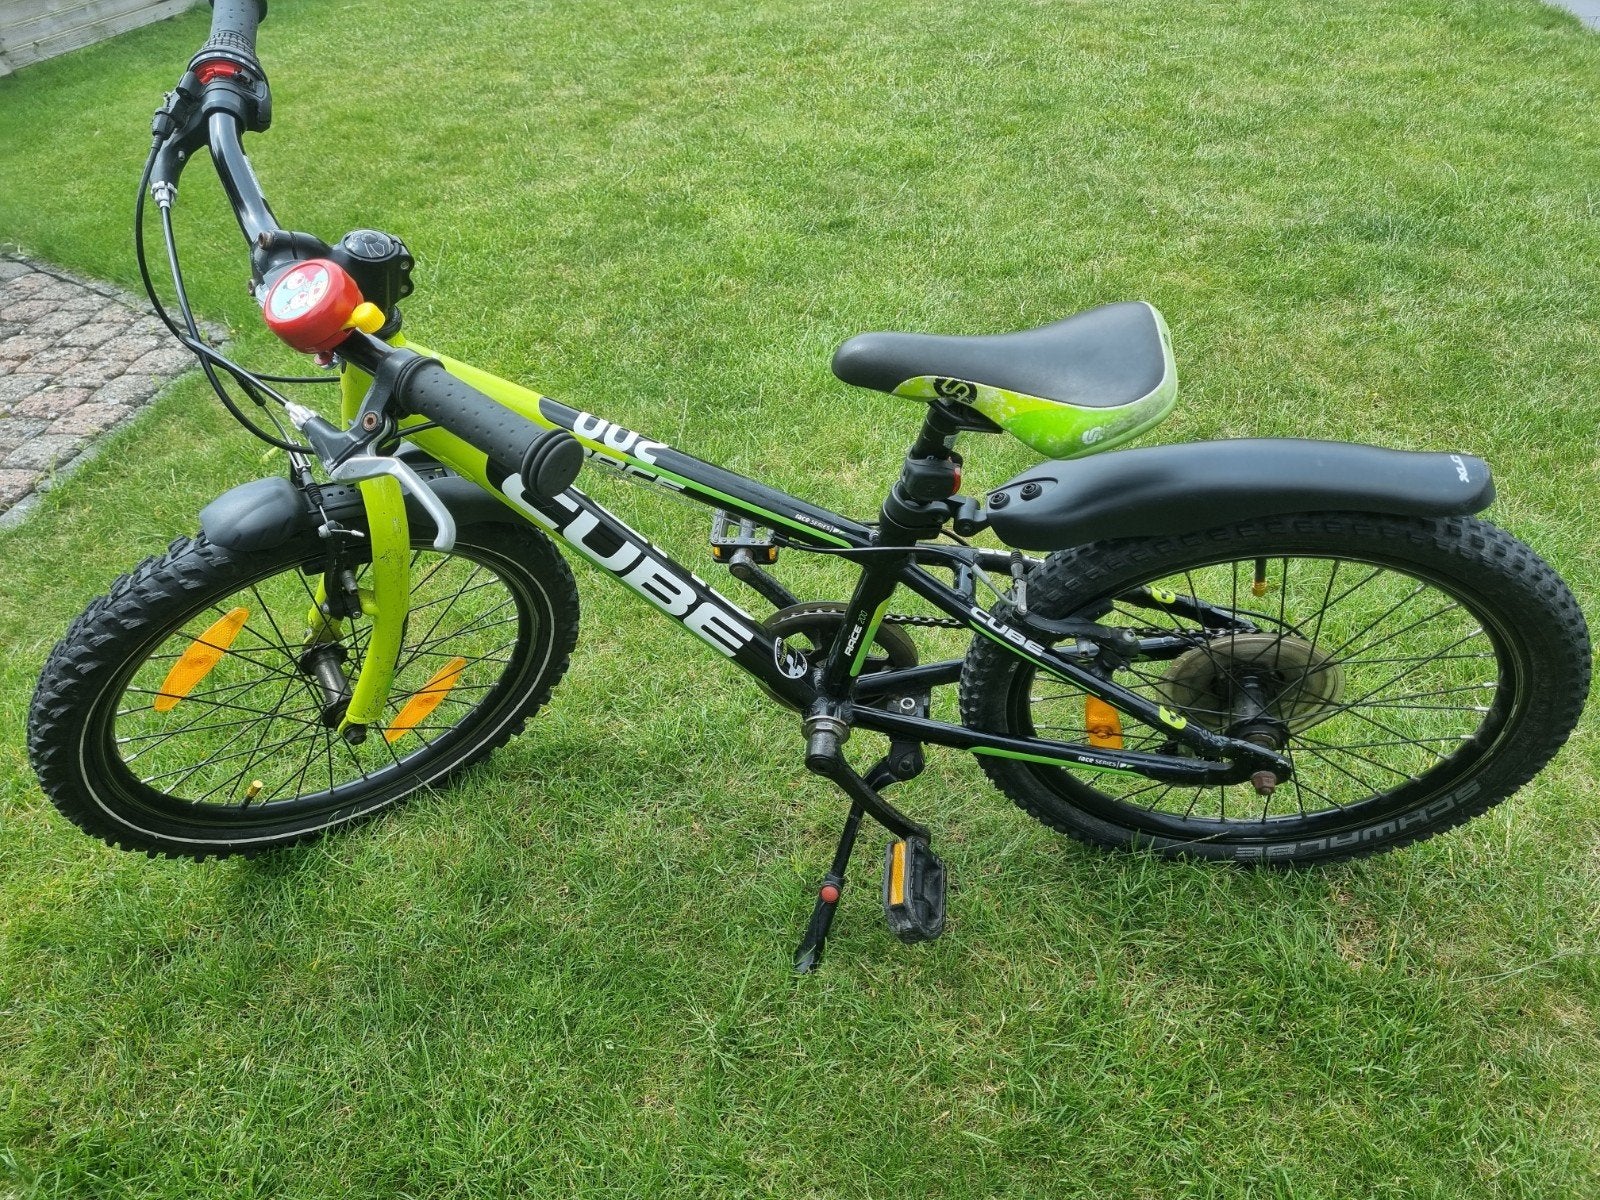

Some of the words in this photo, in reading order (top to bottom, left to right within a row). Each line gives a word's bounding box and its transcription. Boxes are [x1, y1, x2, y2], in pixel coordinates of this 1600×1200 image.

[502, 472, 754, 657] CUBE
[844, 624, 863, 657] RACE
[970, 606, 1046, 657] CUBE
[1234, 778, 1483, 858] SCHWALBE
